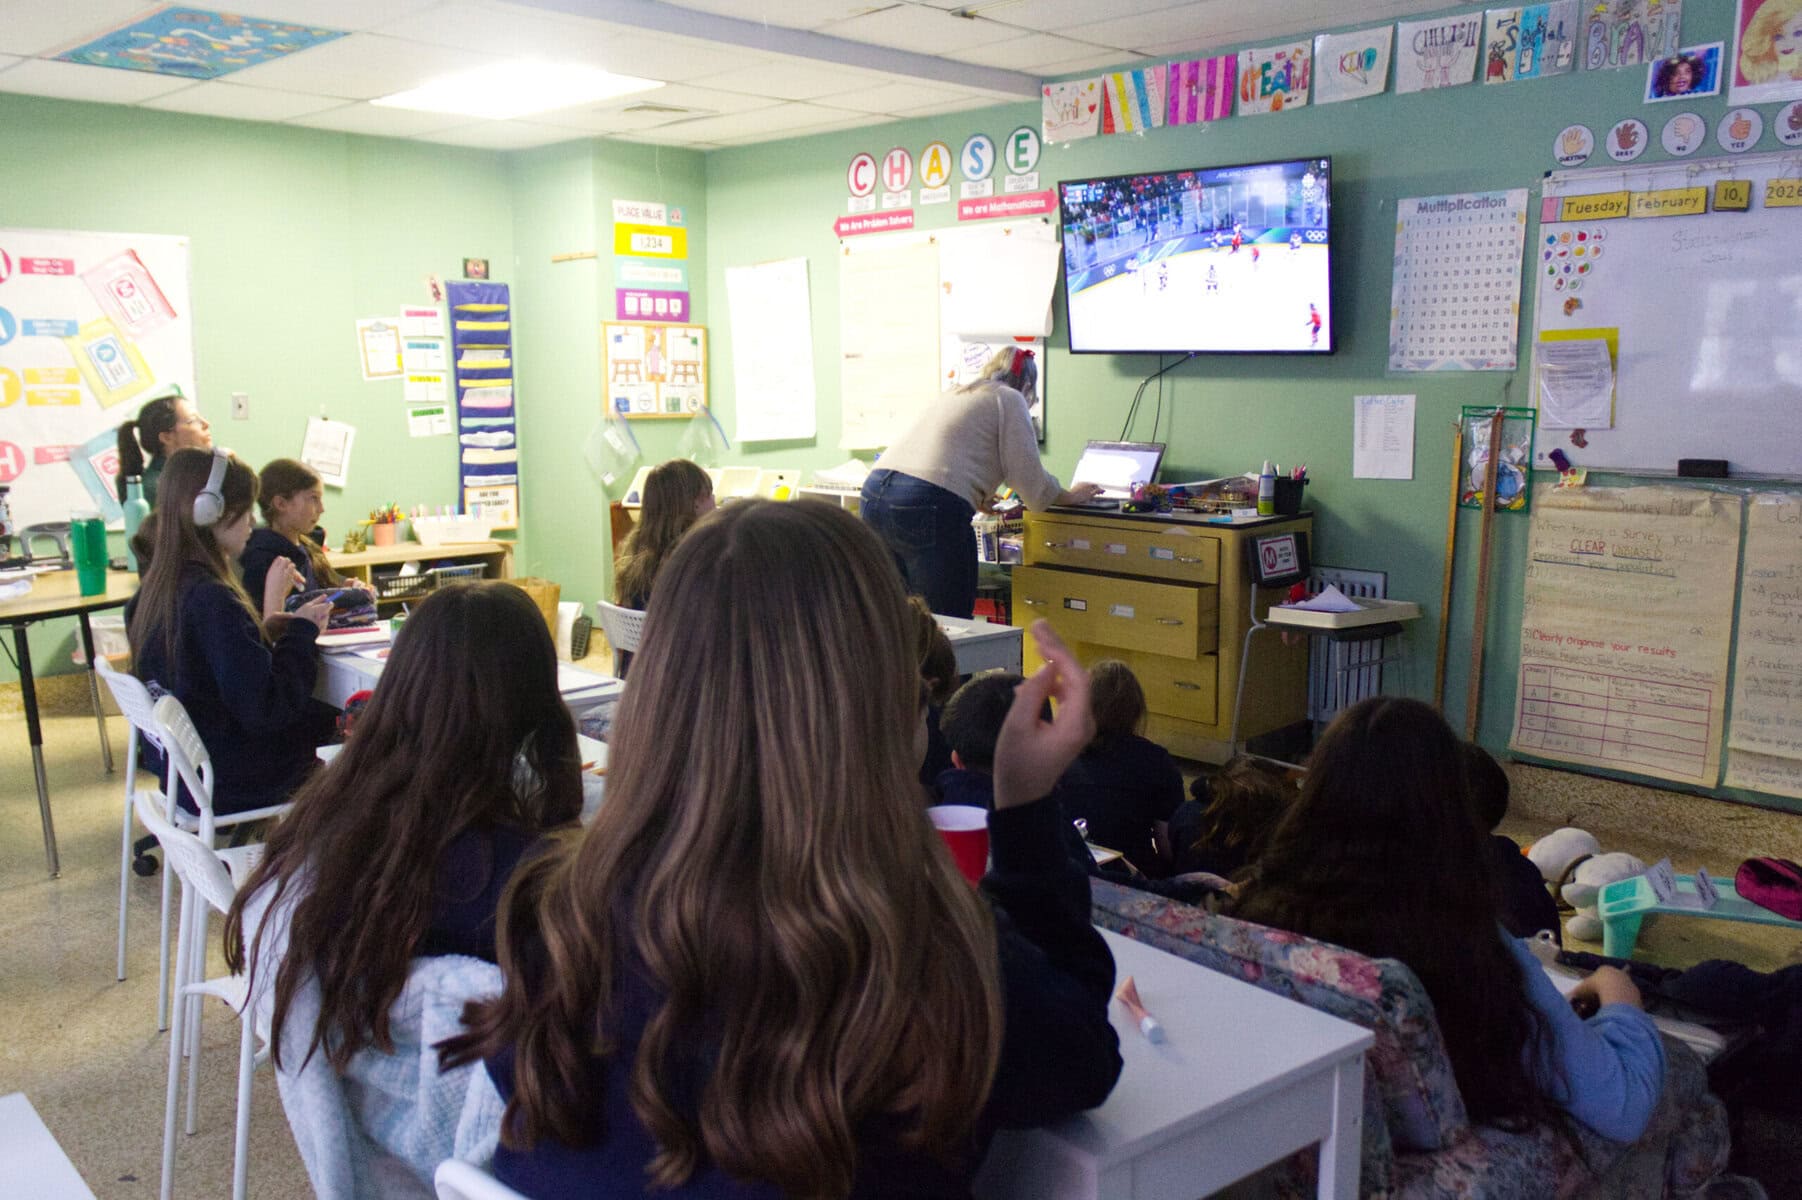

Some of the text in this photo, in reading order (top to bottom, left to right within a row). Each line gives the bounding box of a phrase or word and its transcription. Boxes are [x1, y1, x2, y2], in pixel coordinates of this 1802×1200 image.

[1338, 47, 1377, 73] KIND
[1417, 197, 1507, 214] Multiplication
[1637, 196, 1699, 209] February
[617, 206, 663, 220] PLACE VALUE
